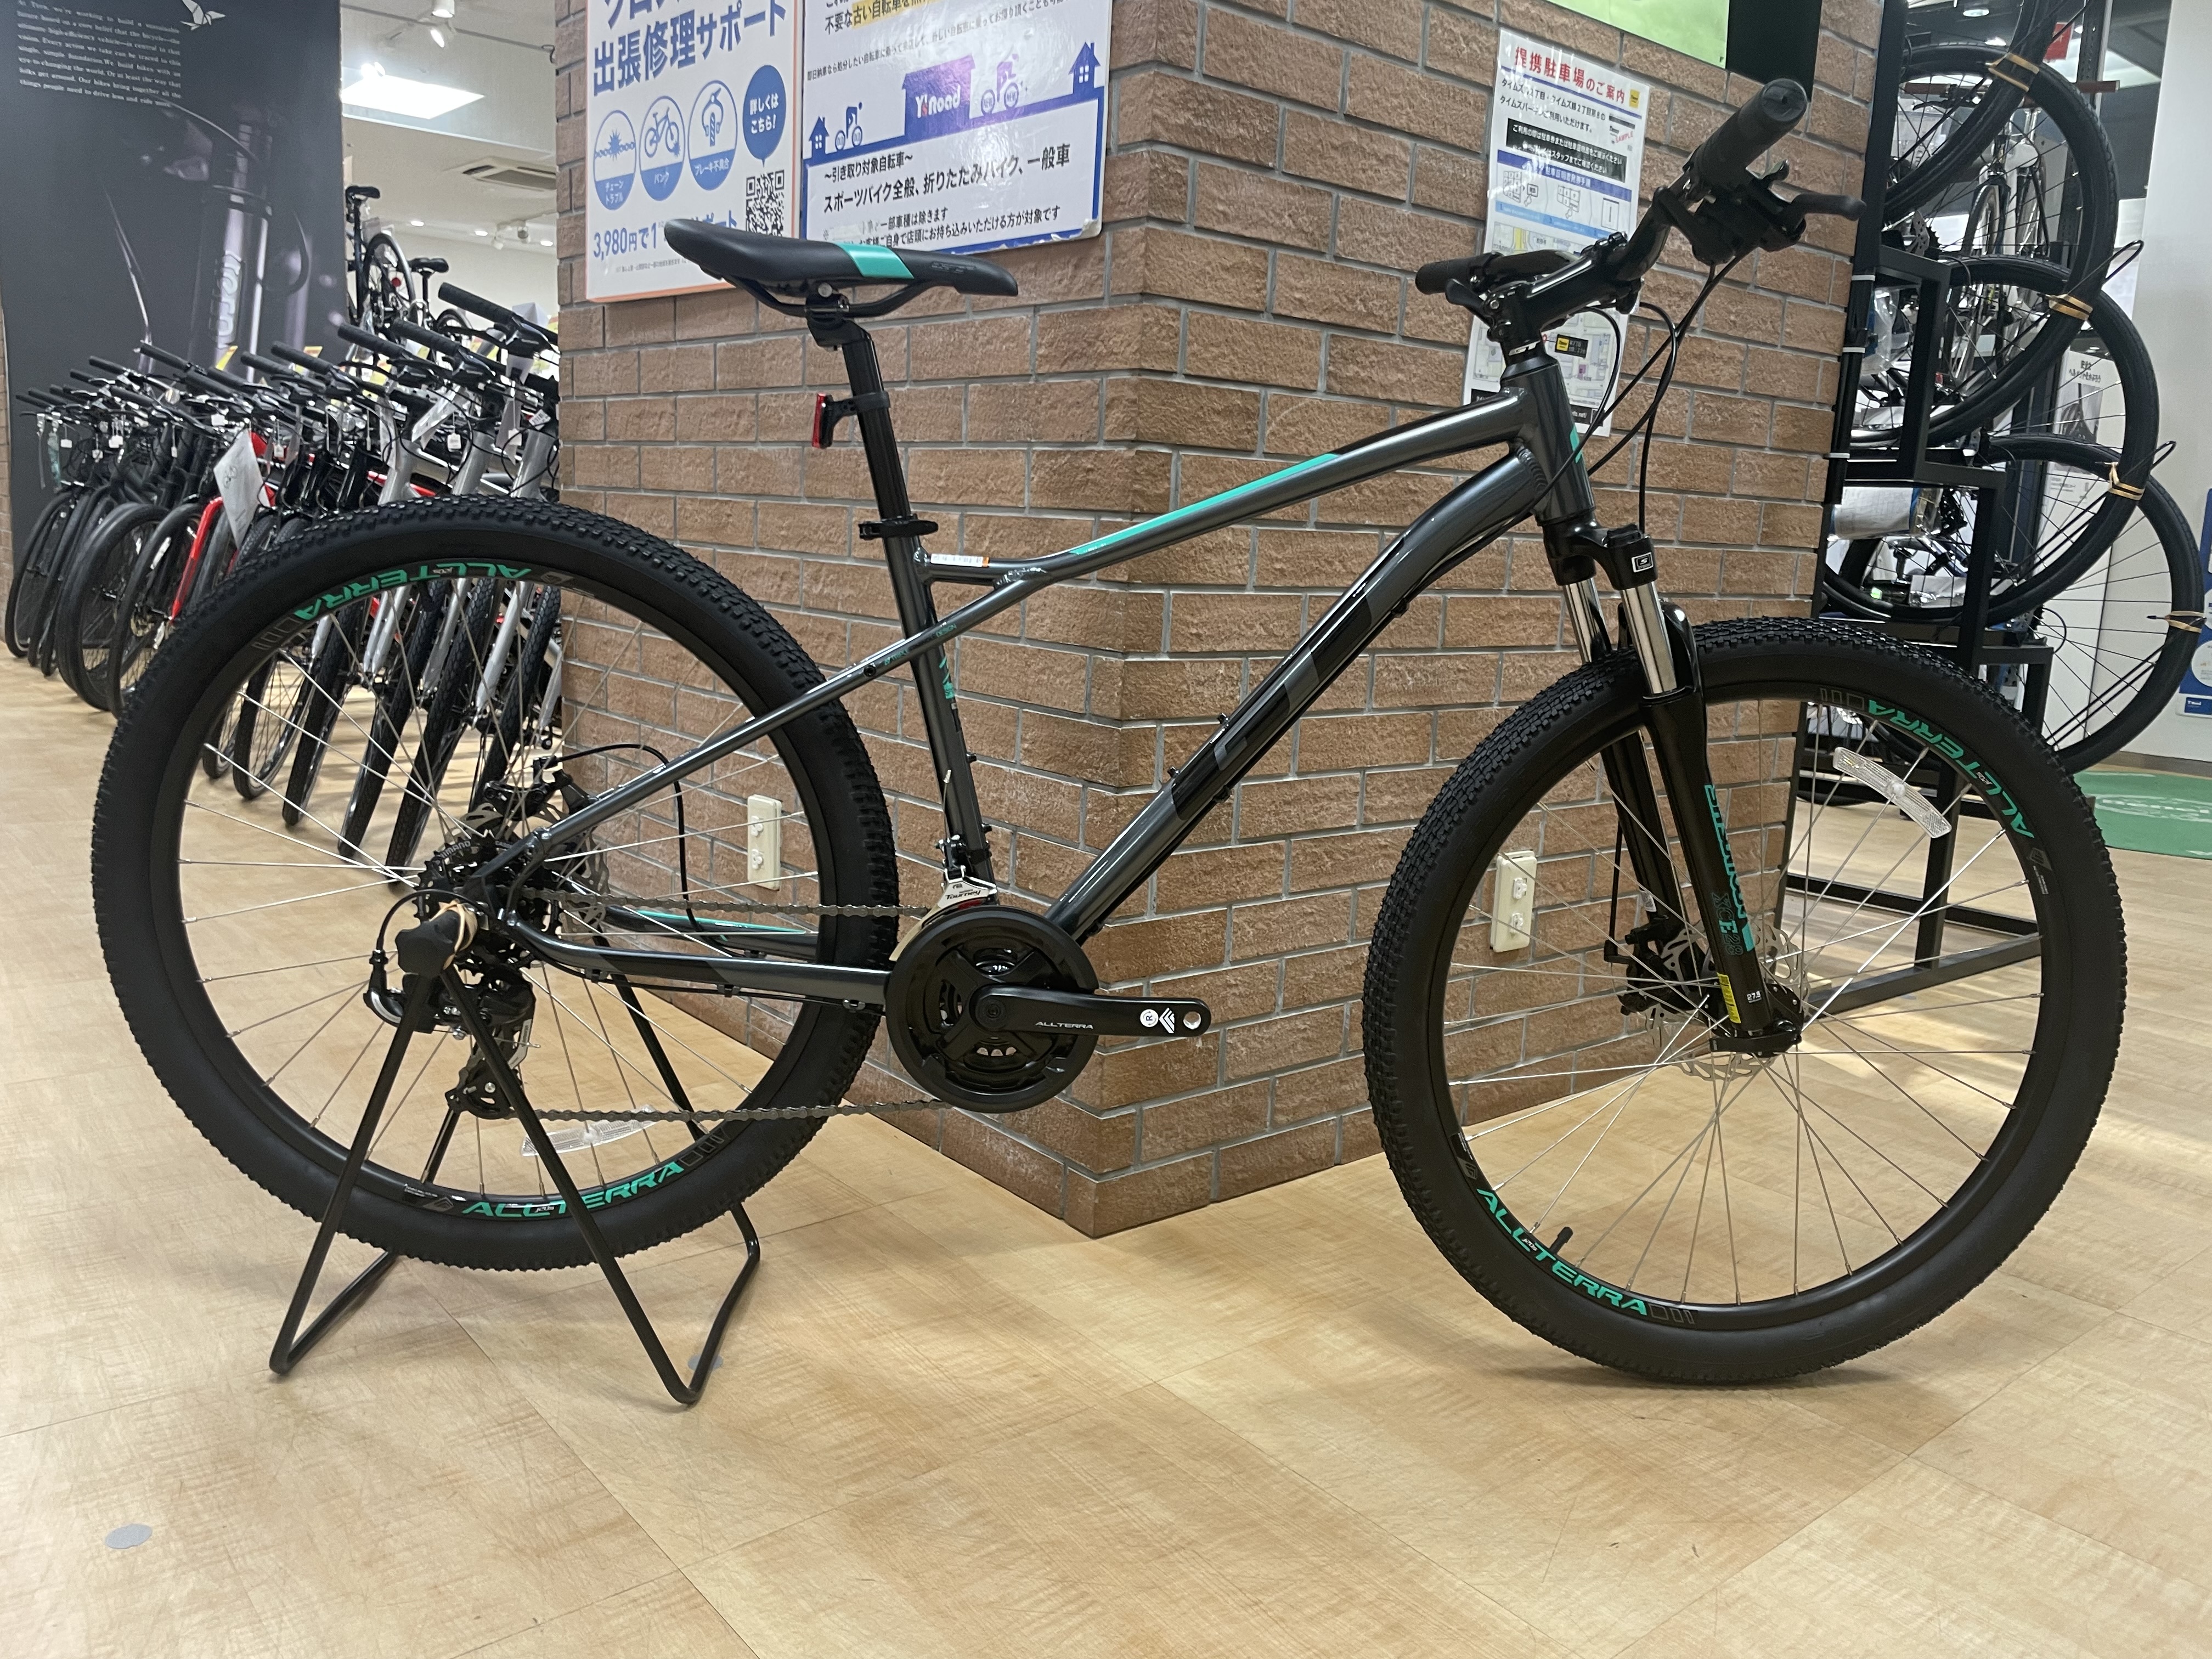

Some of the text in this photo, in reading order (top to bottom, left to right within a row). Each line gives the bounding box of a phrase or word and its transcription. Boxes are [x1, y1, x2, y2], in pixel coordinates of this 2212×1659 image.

[594, 0, 786, 97] 出張修理サポート
[1035, 1021, 1094, 1030] ALLTERRA
[1476, 1188, 1648, 1317] ALLTERRA
